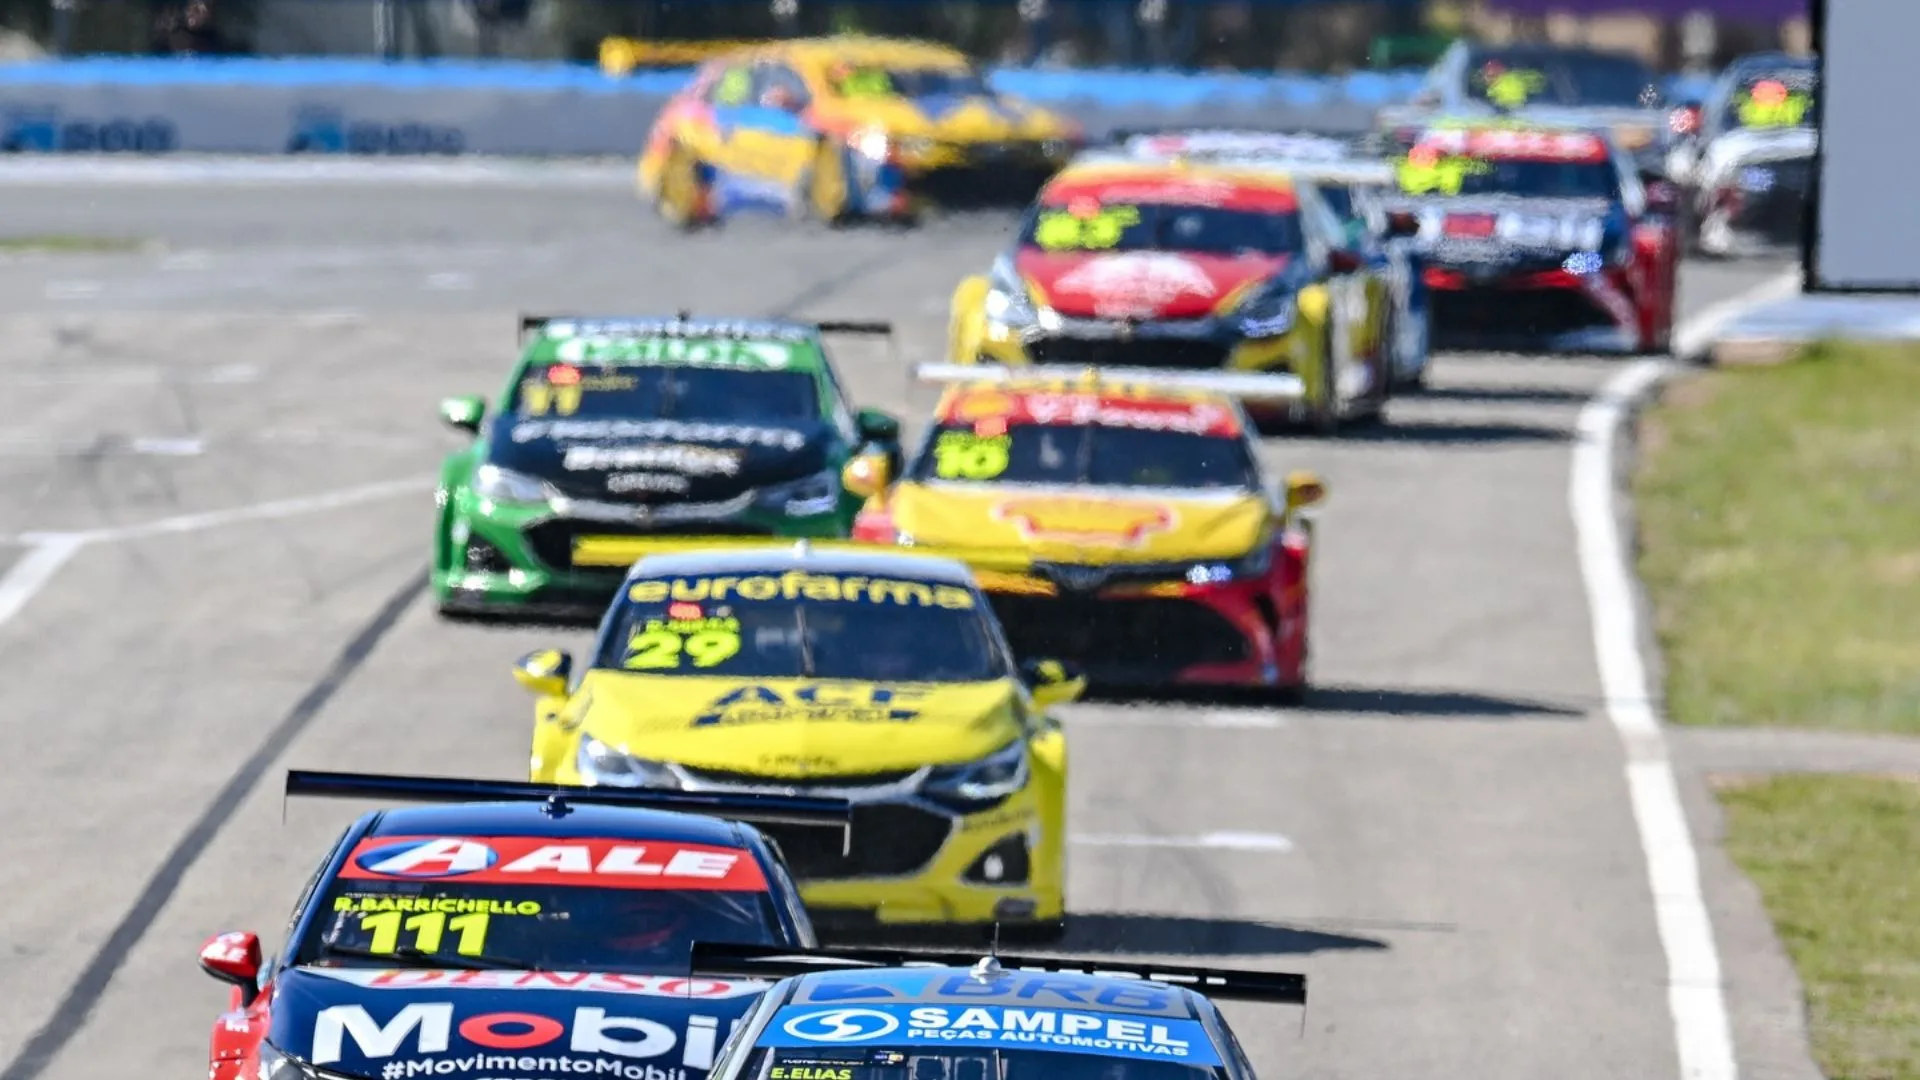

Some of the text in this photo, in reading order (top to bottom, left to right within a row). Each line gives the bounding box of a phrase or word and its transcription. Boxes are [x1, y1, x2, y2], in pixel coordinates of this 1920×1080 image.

[936, 438, 1009, 480] 10
[628, 571, 975, 610] eurofarma
[624, 631, 741, 670] 29
[500, 845, 739, 878] ALE
[334, 897, 542, 915] R.BARRICHELLO
[361, 911, 489, 956] 111
[369, 969, 732, 997] DENSO
[938, 974, 1170, 1012] BRB
[311, 1002, 741, 1071] Mobi
[908, 1007, 1190, 1048] SAMPEL
[908, 1029, 1189, 1056] PEÇAS AUTOMOTIVAS
[381, 1053, 687, 1080] #MovimentoMobil
[770, 1067, 853, 1080] E.ELIAS
